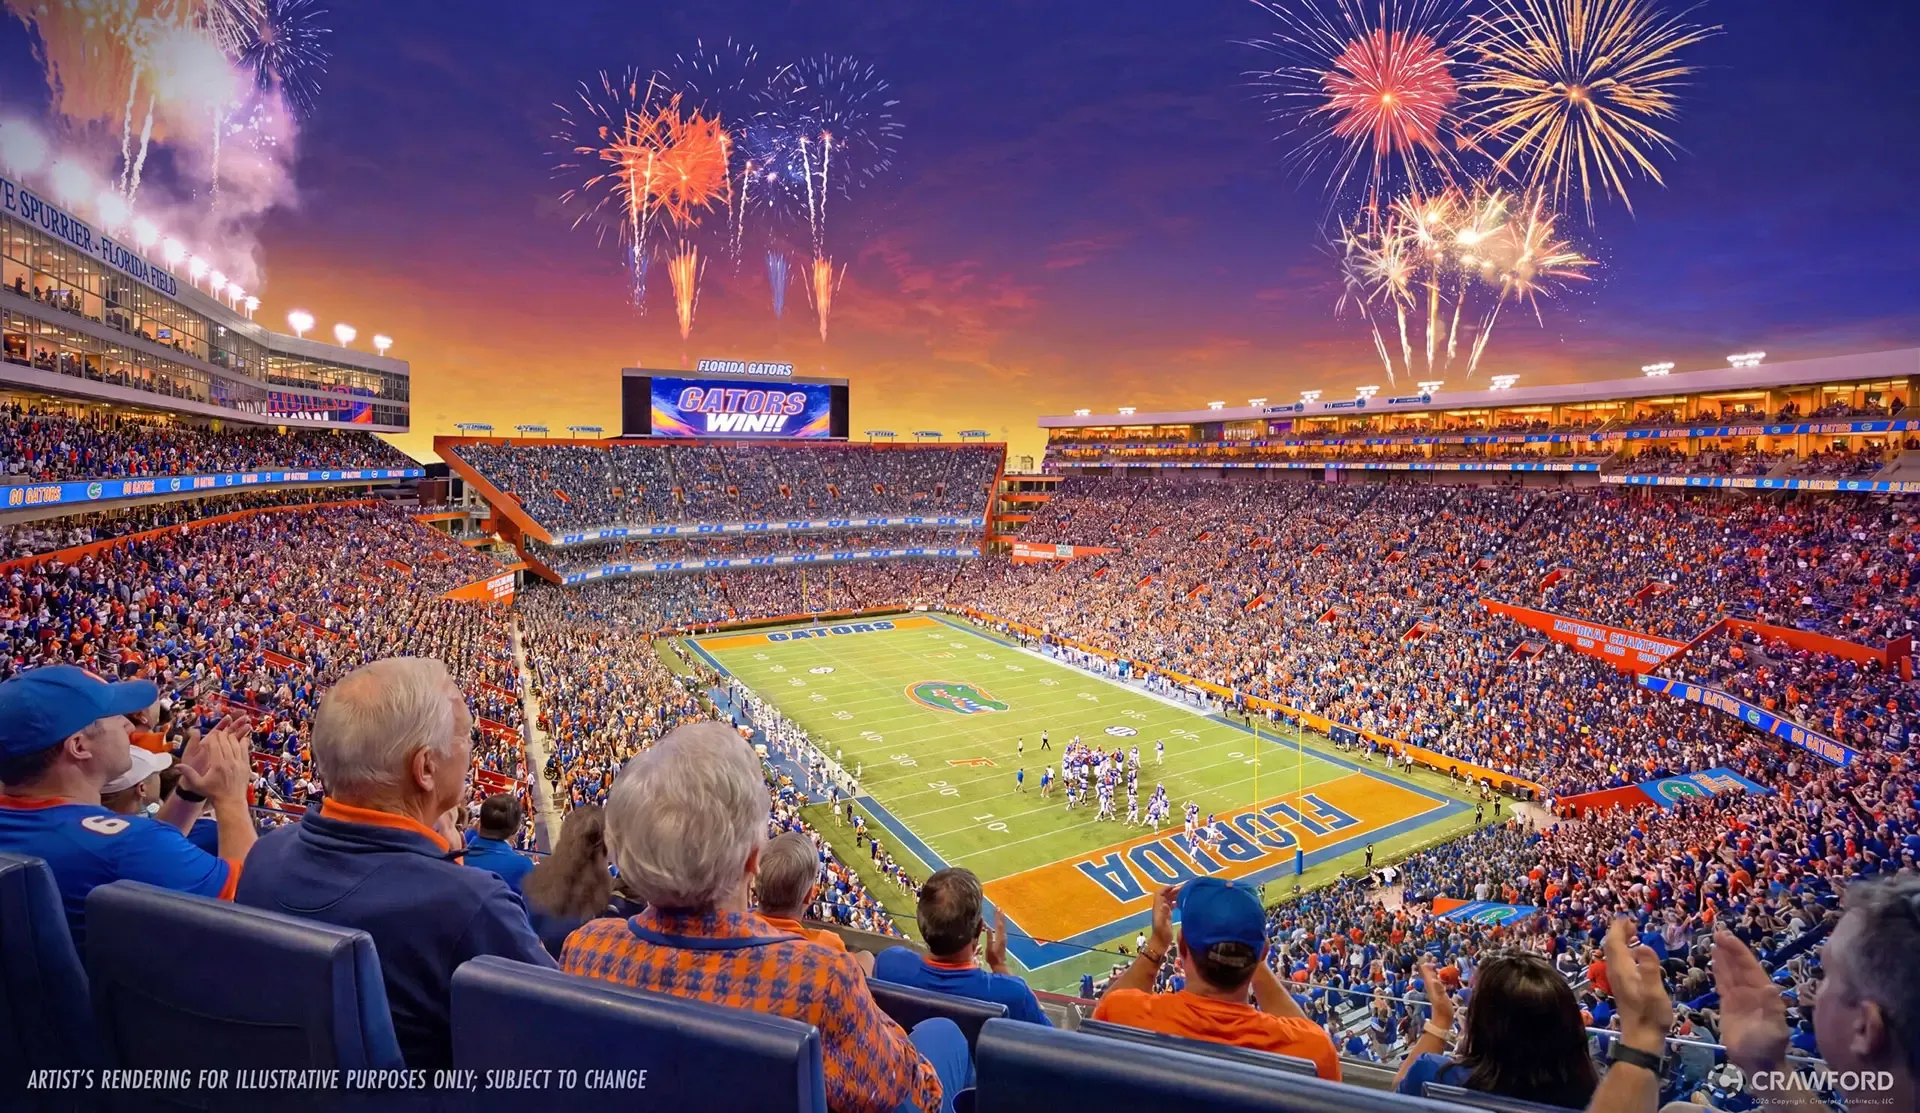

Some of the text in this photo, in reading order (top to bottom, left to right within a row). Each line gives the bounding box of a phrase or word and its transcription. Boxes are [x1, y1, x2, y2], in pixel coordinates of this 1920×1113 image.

[20, 190, 93, 253] SPURRIER
[101, 236, 150, 286] FLORIDA
[150, 266, 177, 297] FIELD
[697, 360, 793, 377] FLORIDA GATORS
[678, 386, 807, 415] GATORS
[705, 412, 789, 432] WIN!!
[9, 485, 62, 506] GO GATORS
[766, 621, 896, 642] GATORS
[1553, 620, 1606, 643] NATIONAL
[1703, 691, 1740, 716] GATORS
[1806, 733, 1844, 763] GATORS
[890, 753, 915, 767] 30
[928, 780, 957, 797] 20
[81, 815, 131, 836] 6
[973, 813, 1006, 832] 10
[1073, 793, 1364, 903] FLORIDA
